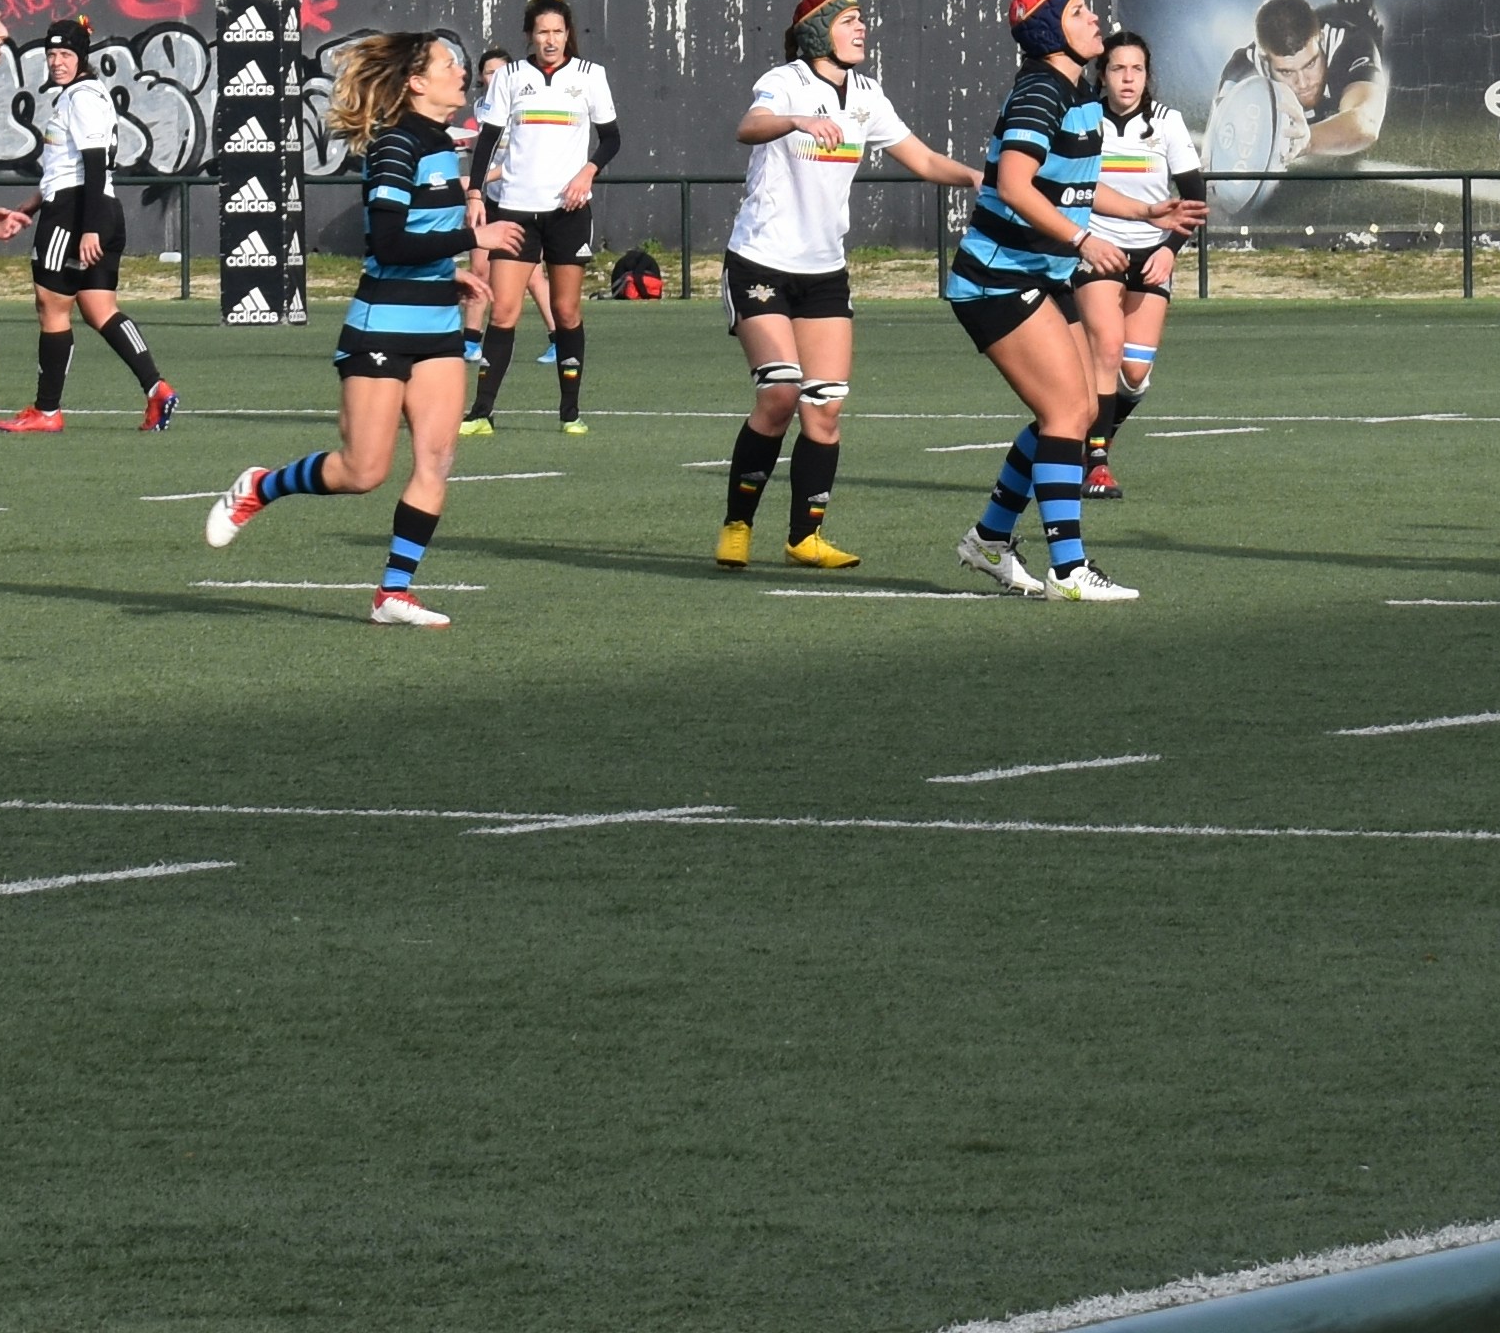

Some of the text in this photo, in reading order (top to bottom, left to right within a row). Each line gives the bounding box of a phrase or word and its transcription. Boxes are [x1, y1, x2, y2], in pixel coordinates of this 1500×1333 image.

[223, 30, 274, 42] adidas
[223, 84, 275, 96] adidas
[224, 140, 275, 153] adidas
[225, 200, 276, 213] adidas
[226, 254, 277, 267] adidas
[227, 311, 278, 323] adidas
